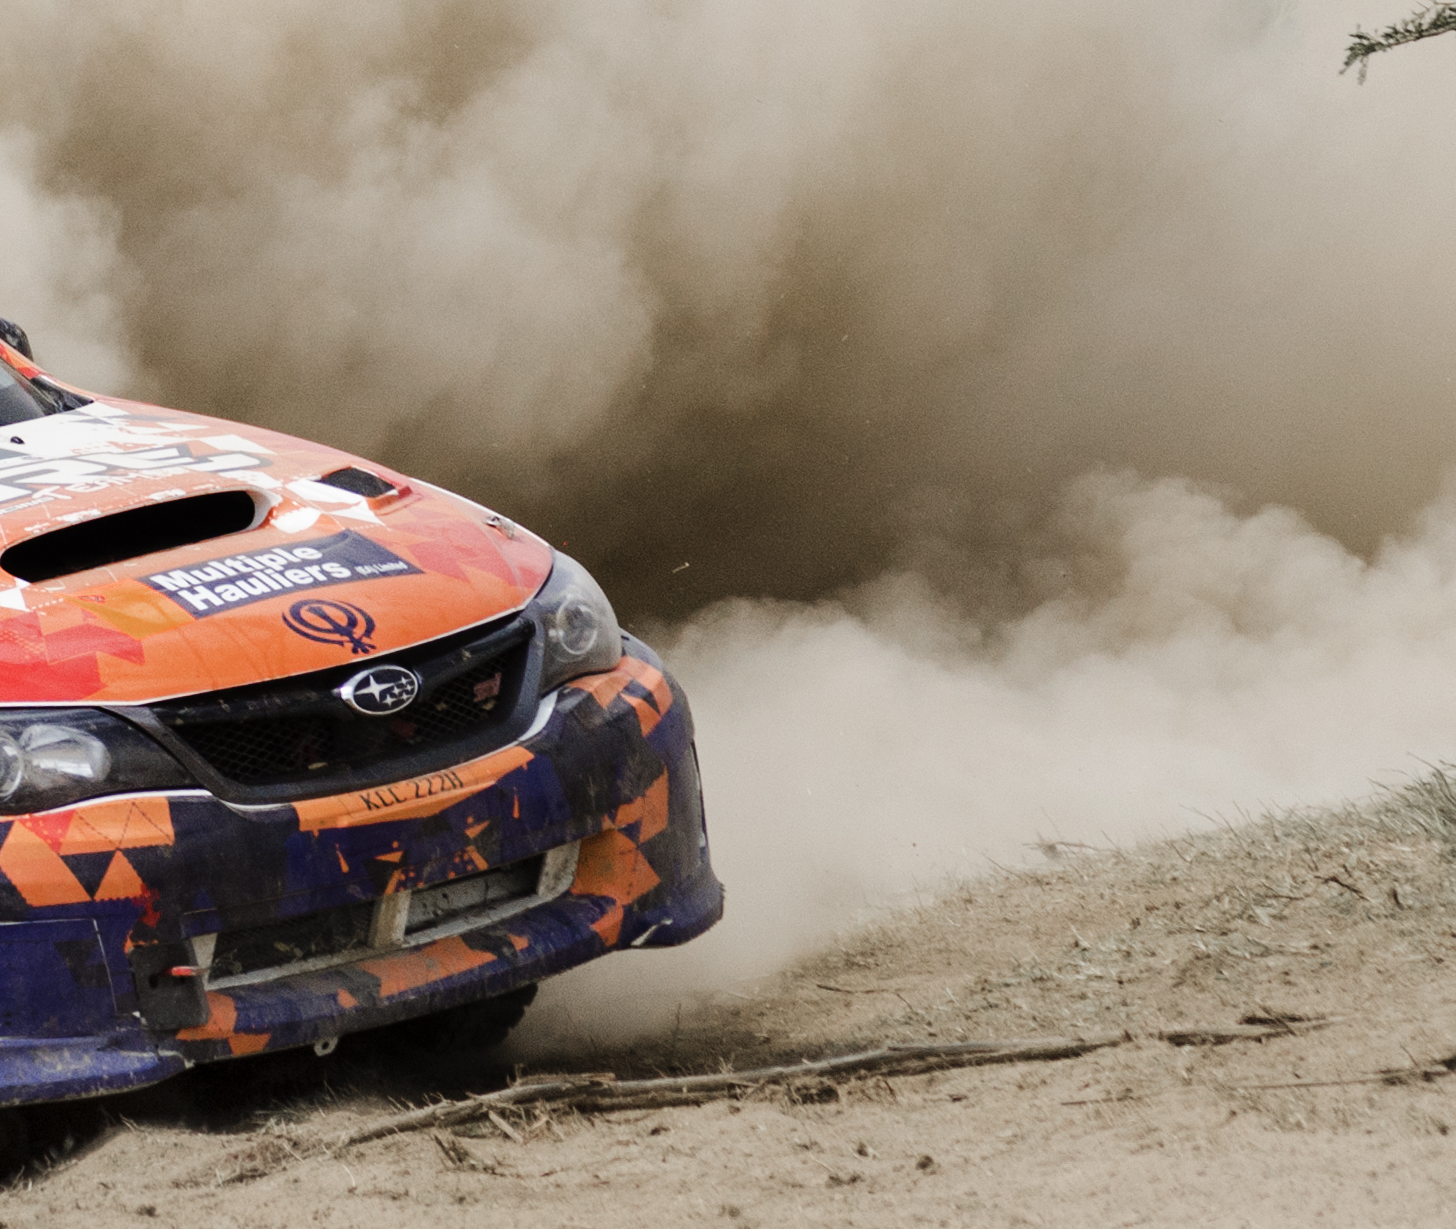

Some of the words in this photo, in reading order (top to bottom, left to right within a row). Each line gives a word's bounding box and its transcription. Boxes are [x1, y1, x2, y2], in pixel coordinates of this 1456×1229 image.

[149, 546, 323, 591] Multiple
[178, 559, 352, 611] Hauliers
[359, 785, 407, 811] KCC
[411, 771, 465, 799] 222H
